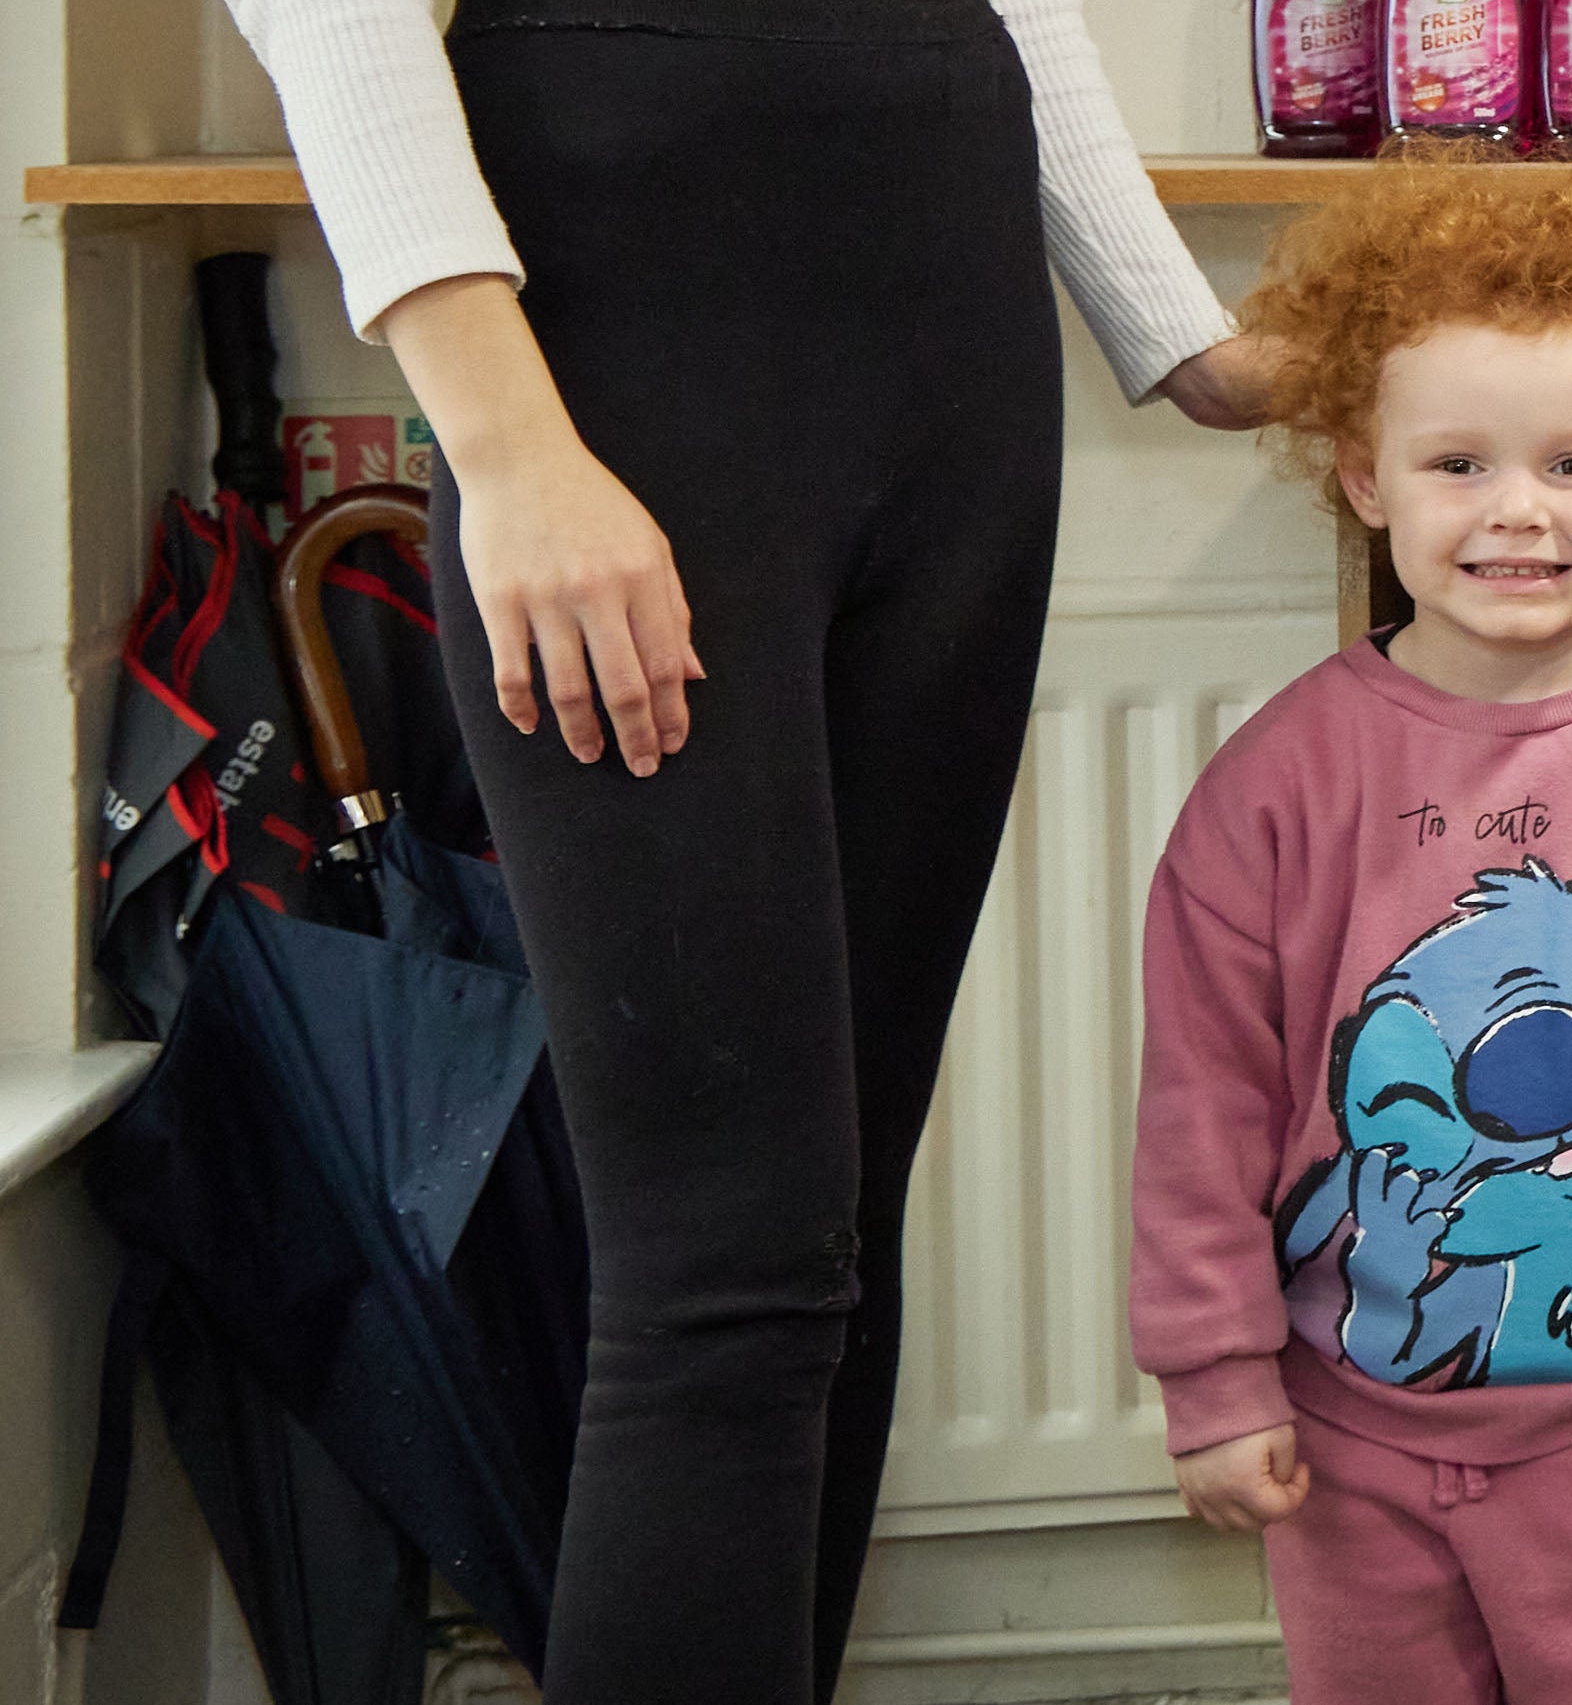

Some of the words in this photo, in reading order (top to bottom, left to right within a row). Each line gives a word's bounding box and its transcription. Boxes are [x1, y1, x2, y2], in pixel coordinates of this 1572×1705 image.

[1300, 9, 1363, 34] FRESH
[1420, 4, 1486, 33] FRESH
[1301, 27, 1363, 52] BERRY
[1421, 25, 1485, 51] BERRY
[1475, 795, 1551, 845] cute
